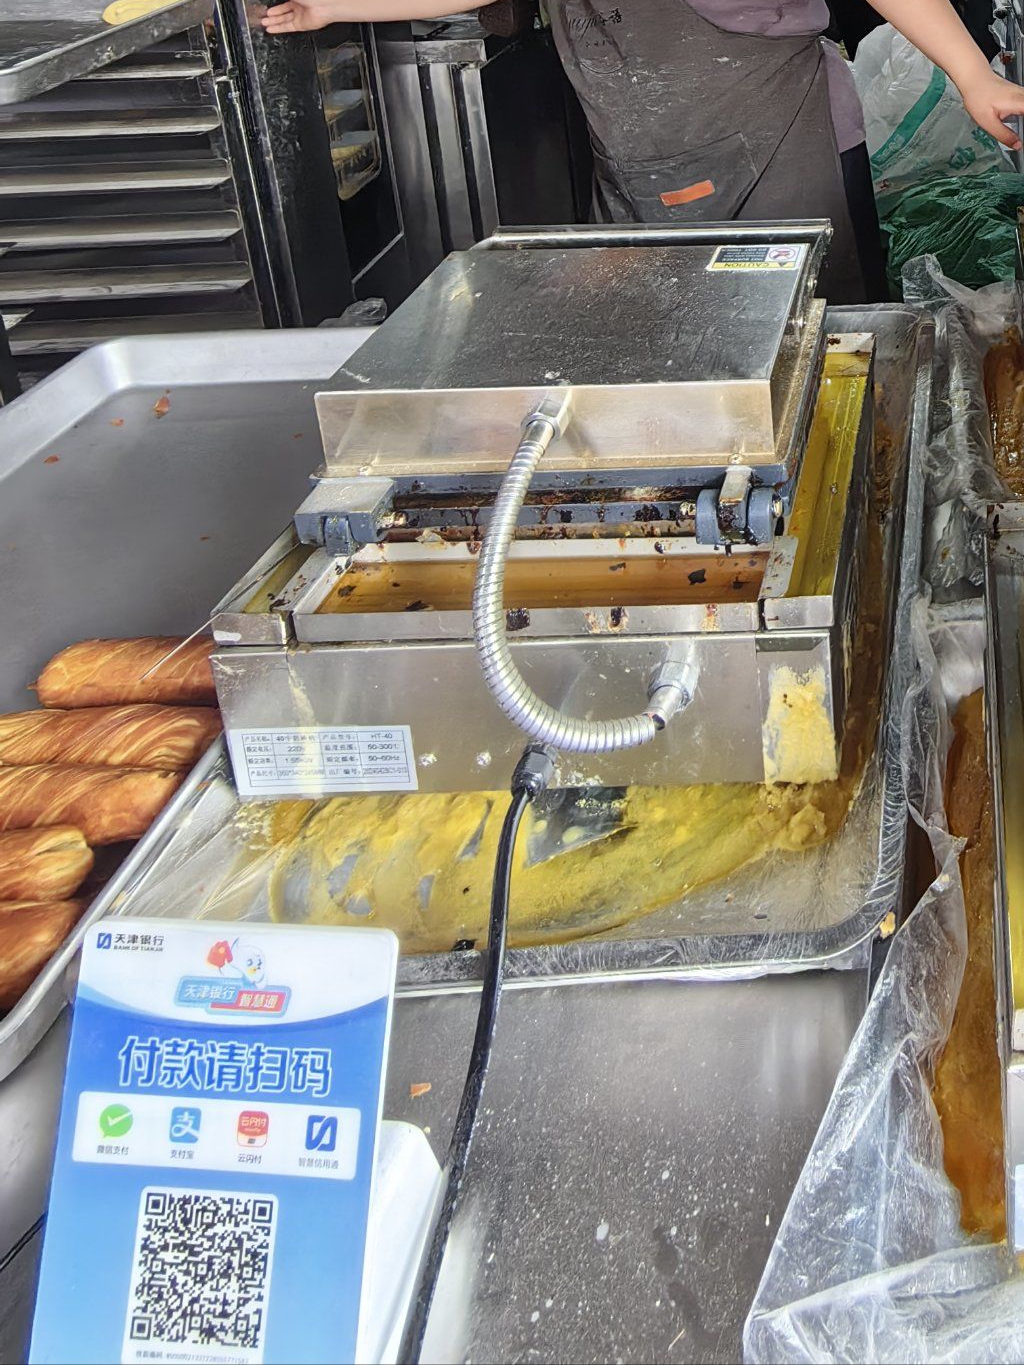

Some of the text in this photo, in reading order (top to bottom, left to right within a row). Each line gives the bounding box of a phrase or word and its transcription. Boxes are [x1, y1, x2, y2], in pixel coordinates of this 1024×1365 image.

[115, 933, 164, 945] 天津银行
[184, 984, 236, 1000] 天津银行
[239, 993, 279, 1009] 智慧通
[118, 1035, 333, 1099] 付款请扫码
[97, 1145, 129, 1156] 微信支付
[170, 1149, 195, 1160] 支付宝
[238, 1153, 262, 1165] 云闪付
